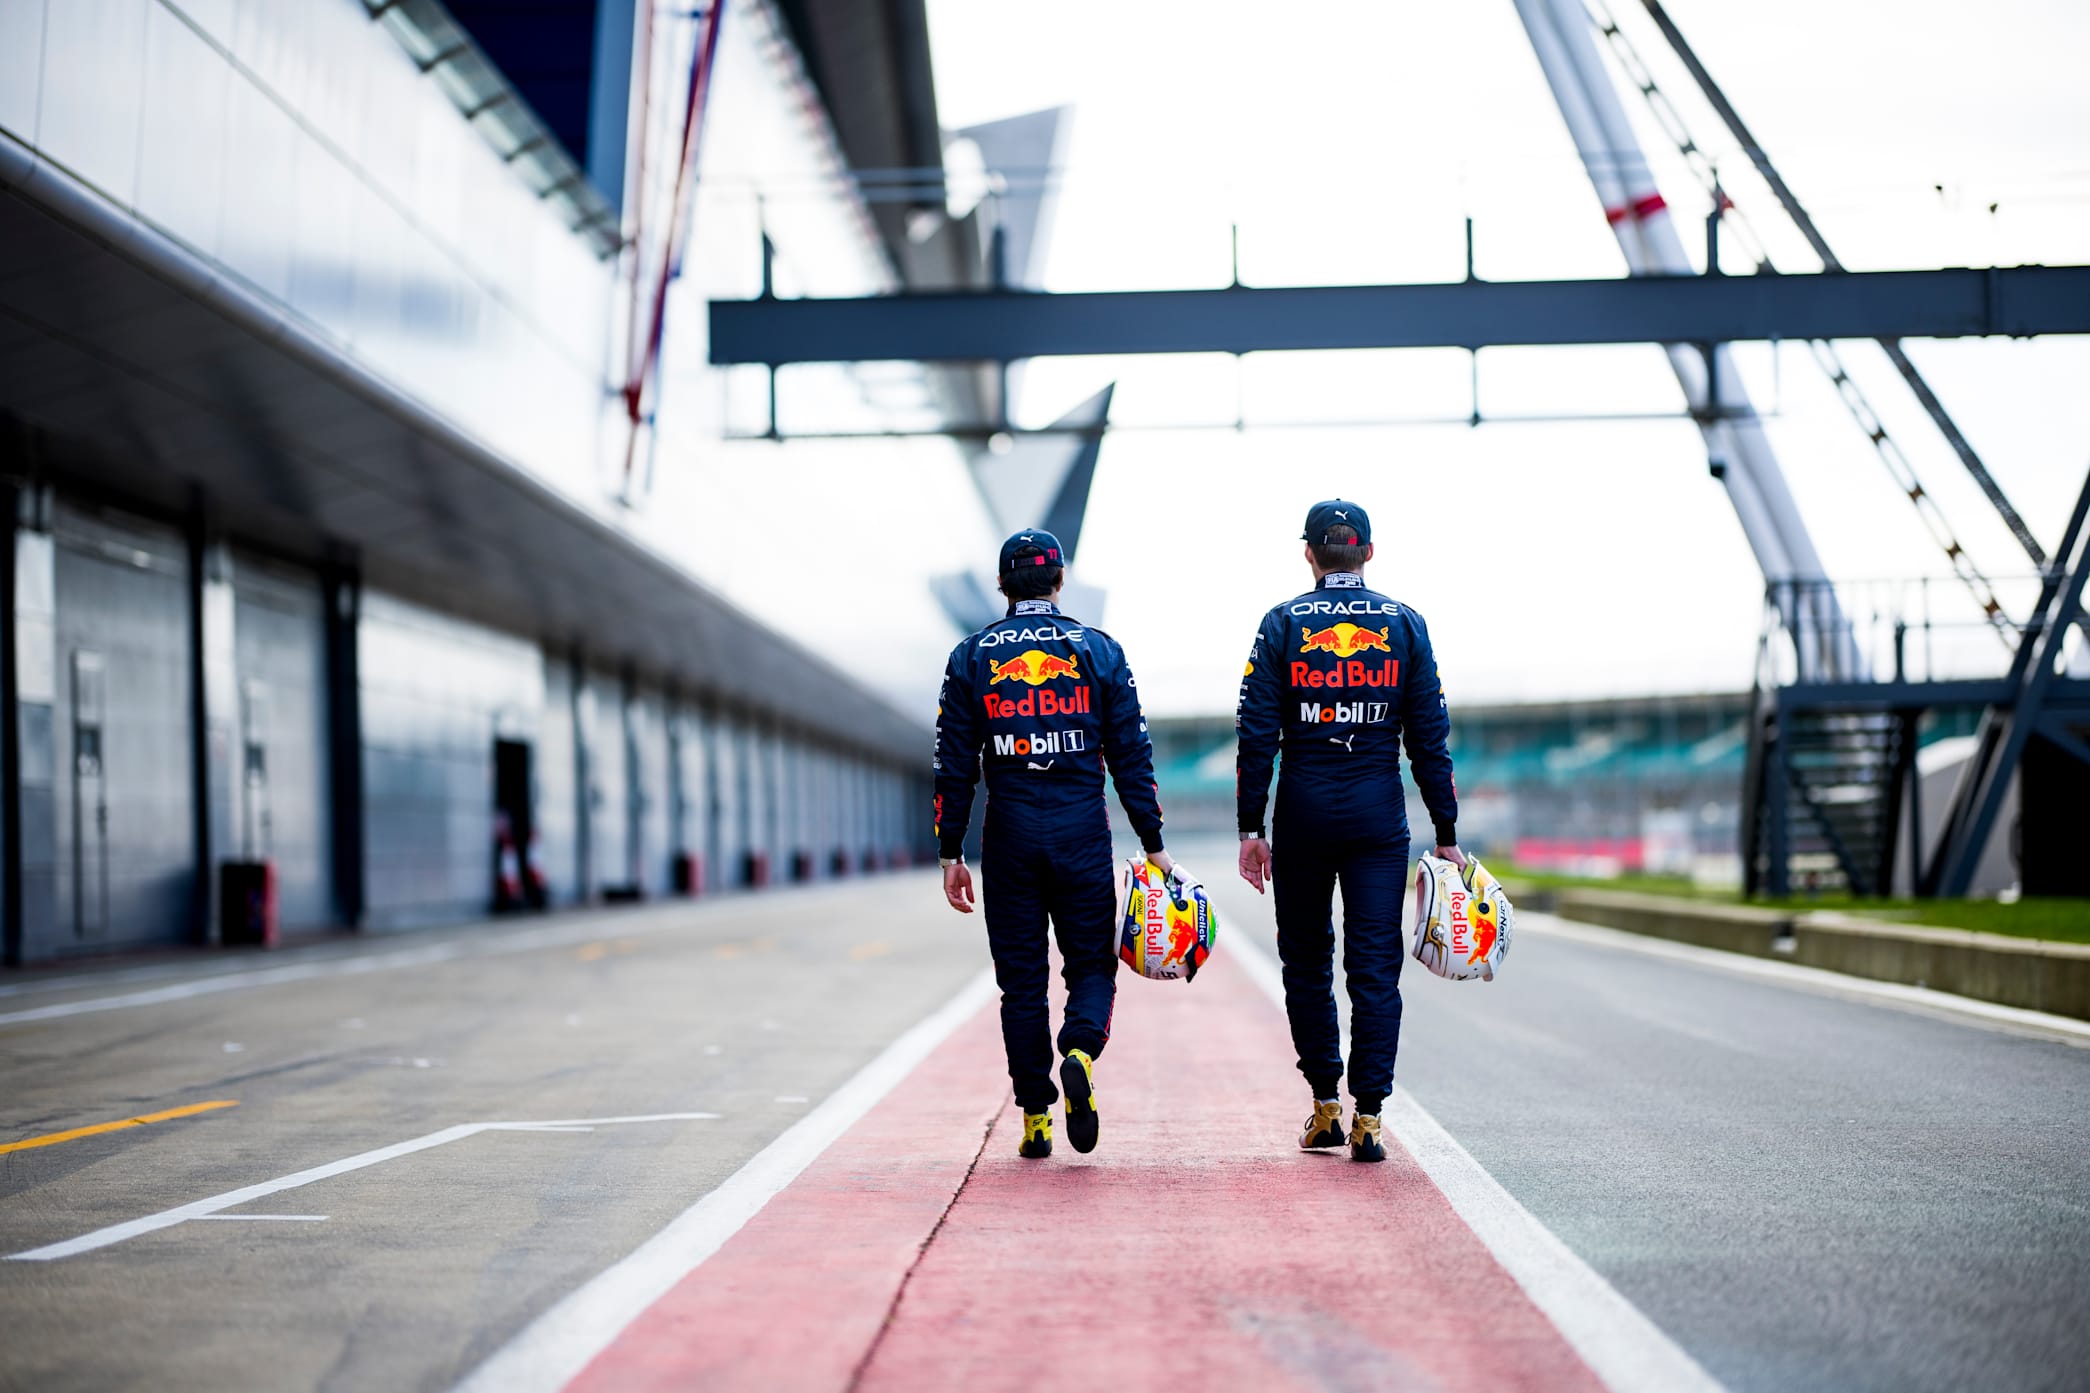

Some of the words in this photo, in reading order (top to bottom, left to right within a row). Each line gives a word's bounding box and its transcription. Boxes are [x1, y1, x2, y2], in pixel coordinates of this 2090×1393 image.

[1290, 600, 1399, 616] ORACLE
[979, 627, 1083, 648] ORACLE
[1290, 660, 1343, 688] Red
[1347, 659, 1399, 687] Bull
[983, 688, 1035, 719] Red
[1039, 685, 1090, 716] Bull
[1300, 702, 1363, 723] Mobil
[994, 732, 1060, 755] Mobil
[1147, 888, 1163, 920] Red
[1451, 892, 1468, 921] Red
[1146, 923, 1164, 956] Bull
[1453, 924, 1469, 954] Bull
